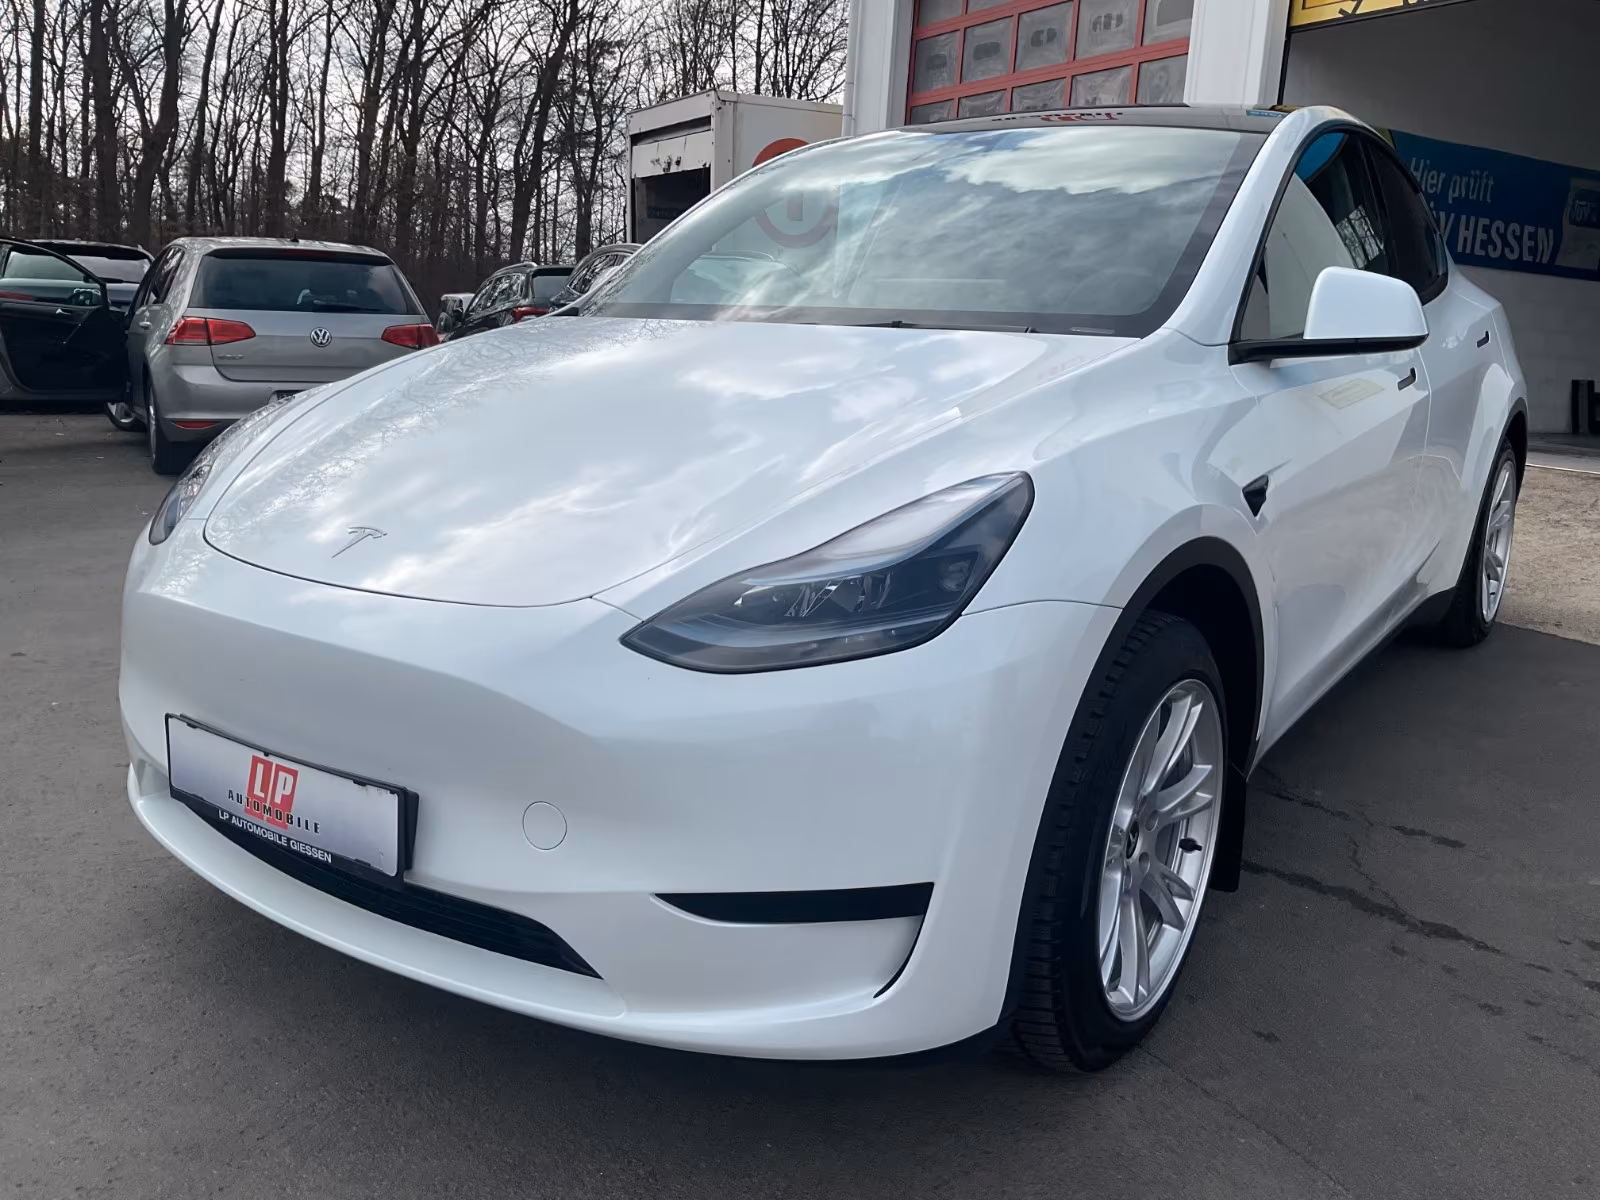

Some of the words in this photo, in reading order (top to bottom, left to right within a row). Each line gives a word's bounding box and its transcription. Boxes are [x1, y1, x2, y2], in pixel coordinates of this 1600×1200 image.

[1448, 169, 1495, 204] prüft
[1456, 214, 1554, 265] HESSEN
[253, 761, 294, 805] LP
[227, 789, 321, 835] AUTOMOBILE
[218, 809, 230, 821] LP
[231, 815, 289, 848] AUTOMOBILE
[290, 839, 333, 865] GIESSEN
